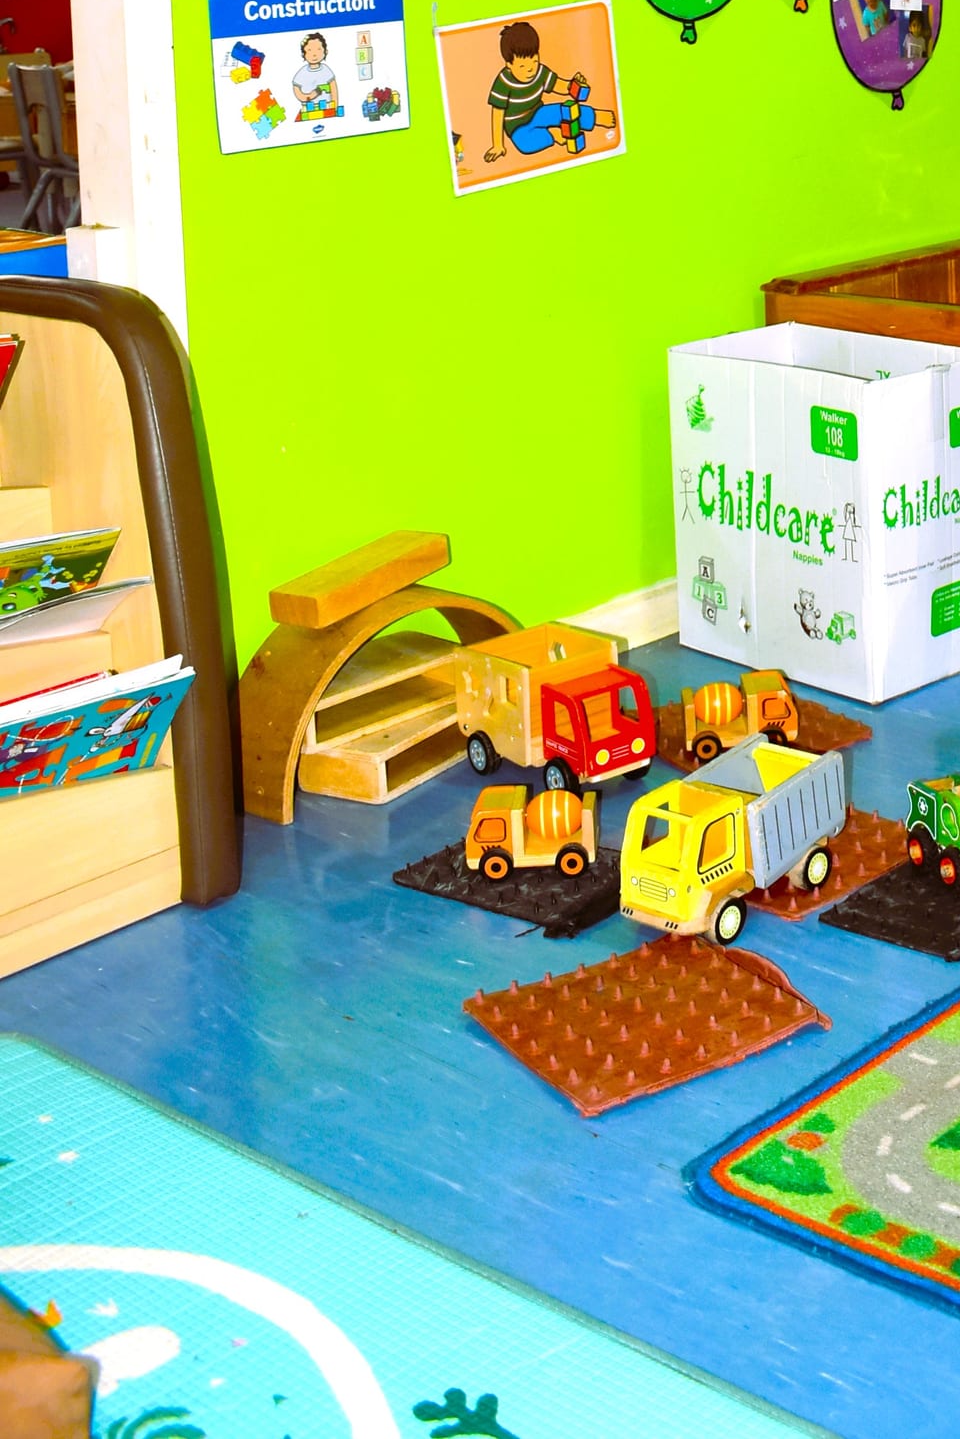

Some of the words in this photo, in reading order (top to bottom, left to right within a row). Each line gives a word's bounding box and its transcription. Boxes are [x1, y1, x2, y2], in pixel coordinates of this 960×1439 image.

[820, 409, 848, 426] Walker
[825, 425, 843, 448] 108
[697, 461, 836, 557] Childcare
[793, 550, 823, 565] Nappies
[702, 566, 710, 579] A
